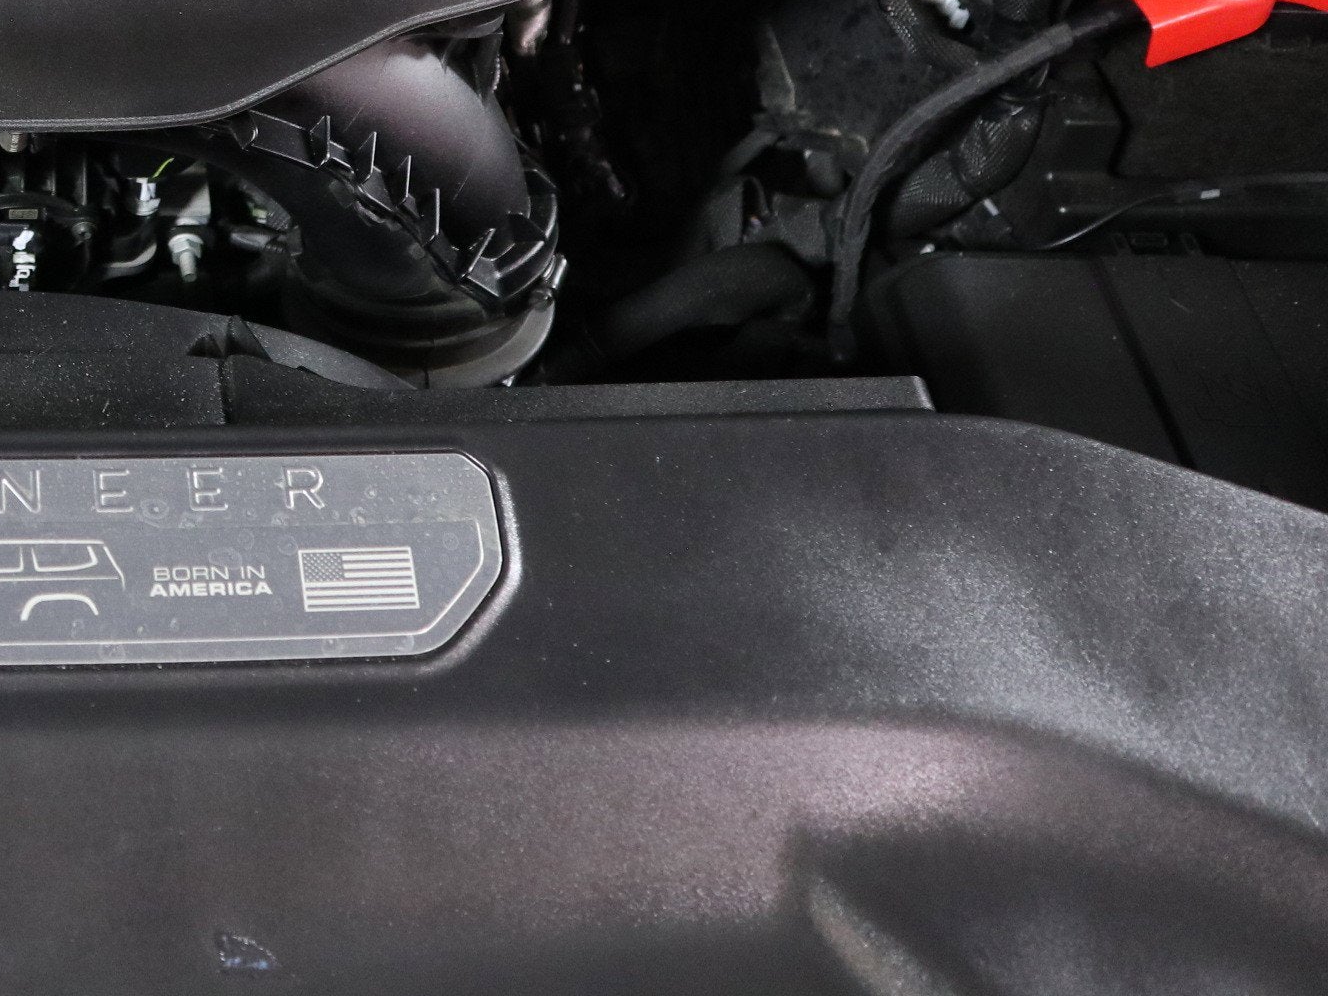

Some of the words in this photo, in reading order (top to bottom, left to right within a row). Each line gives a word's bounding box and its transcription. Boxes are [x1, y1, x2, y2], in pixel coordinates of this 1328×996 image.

[153, 566, 230, 581] BORN
[240, 565, 266, 579] IN
[150, 581, 273, 597] AMERICA
